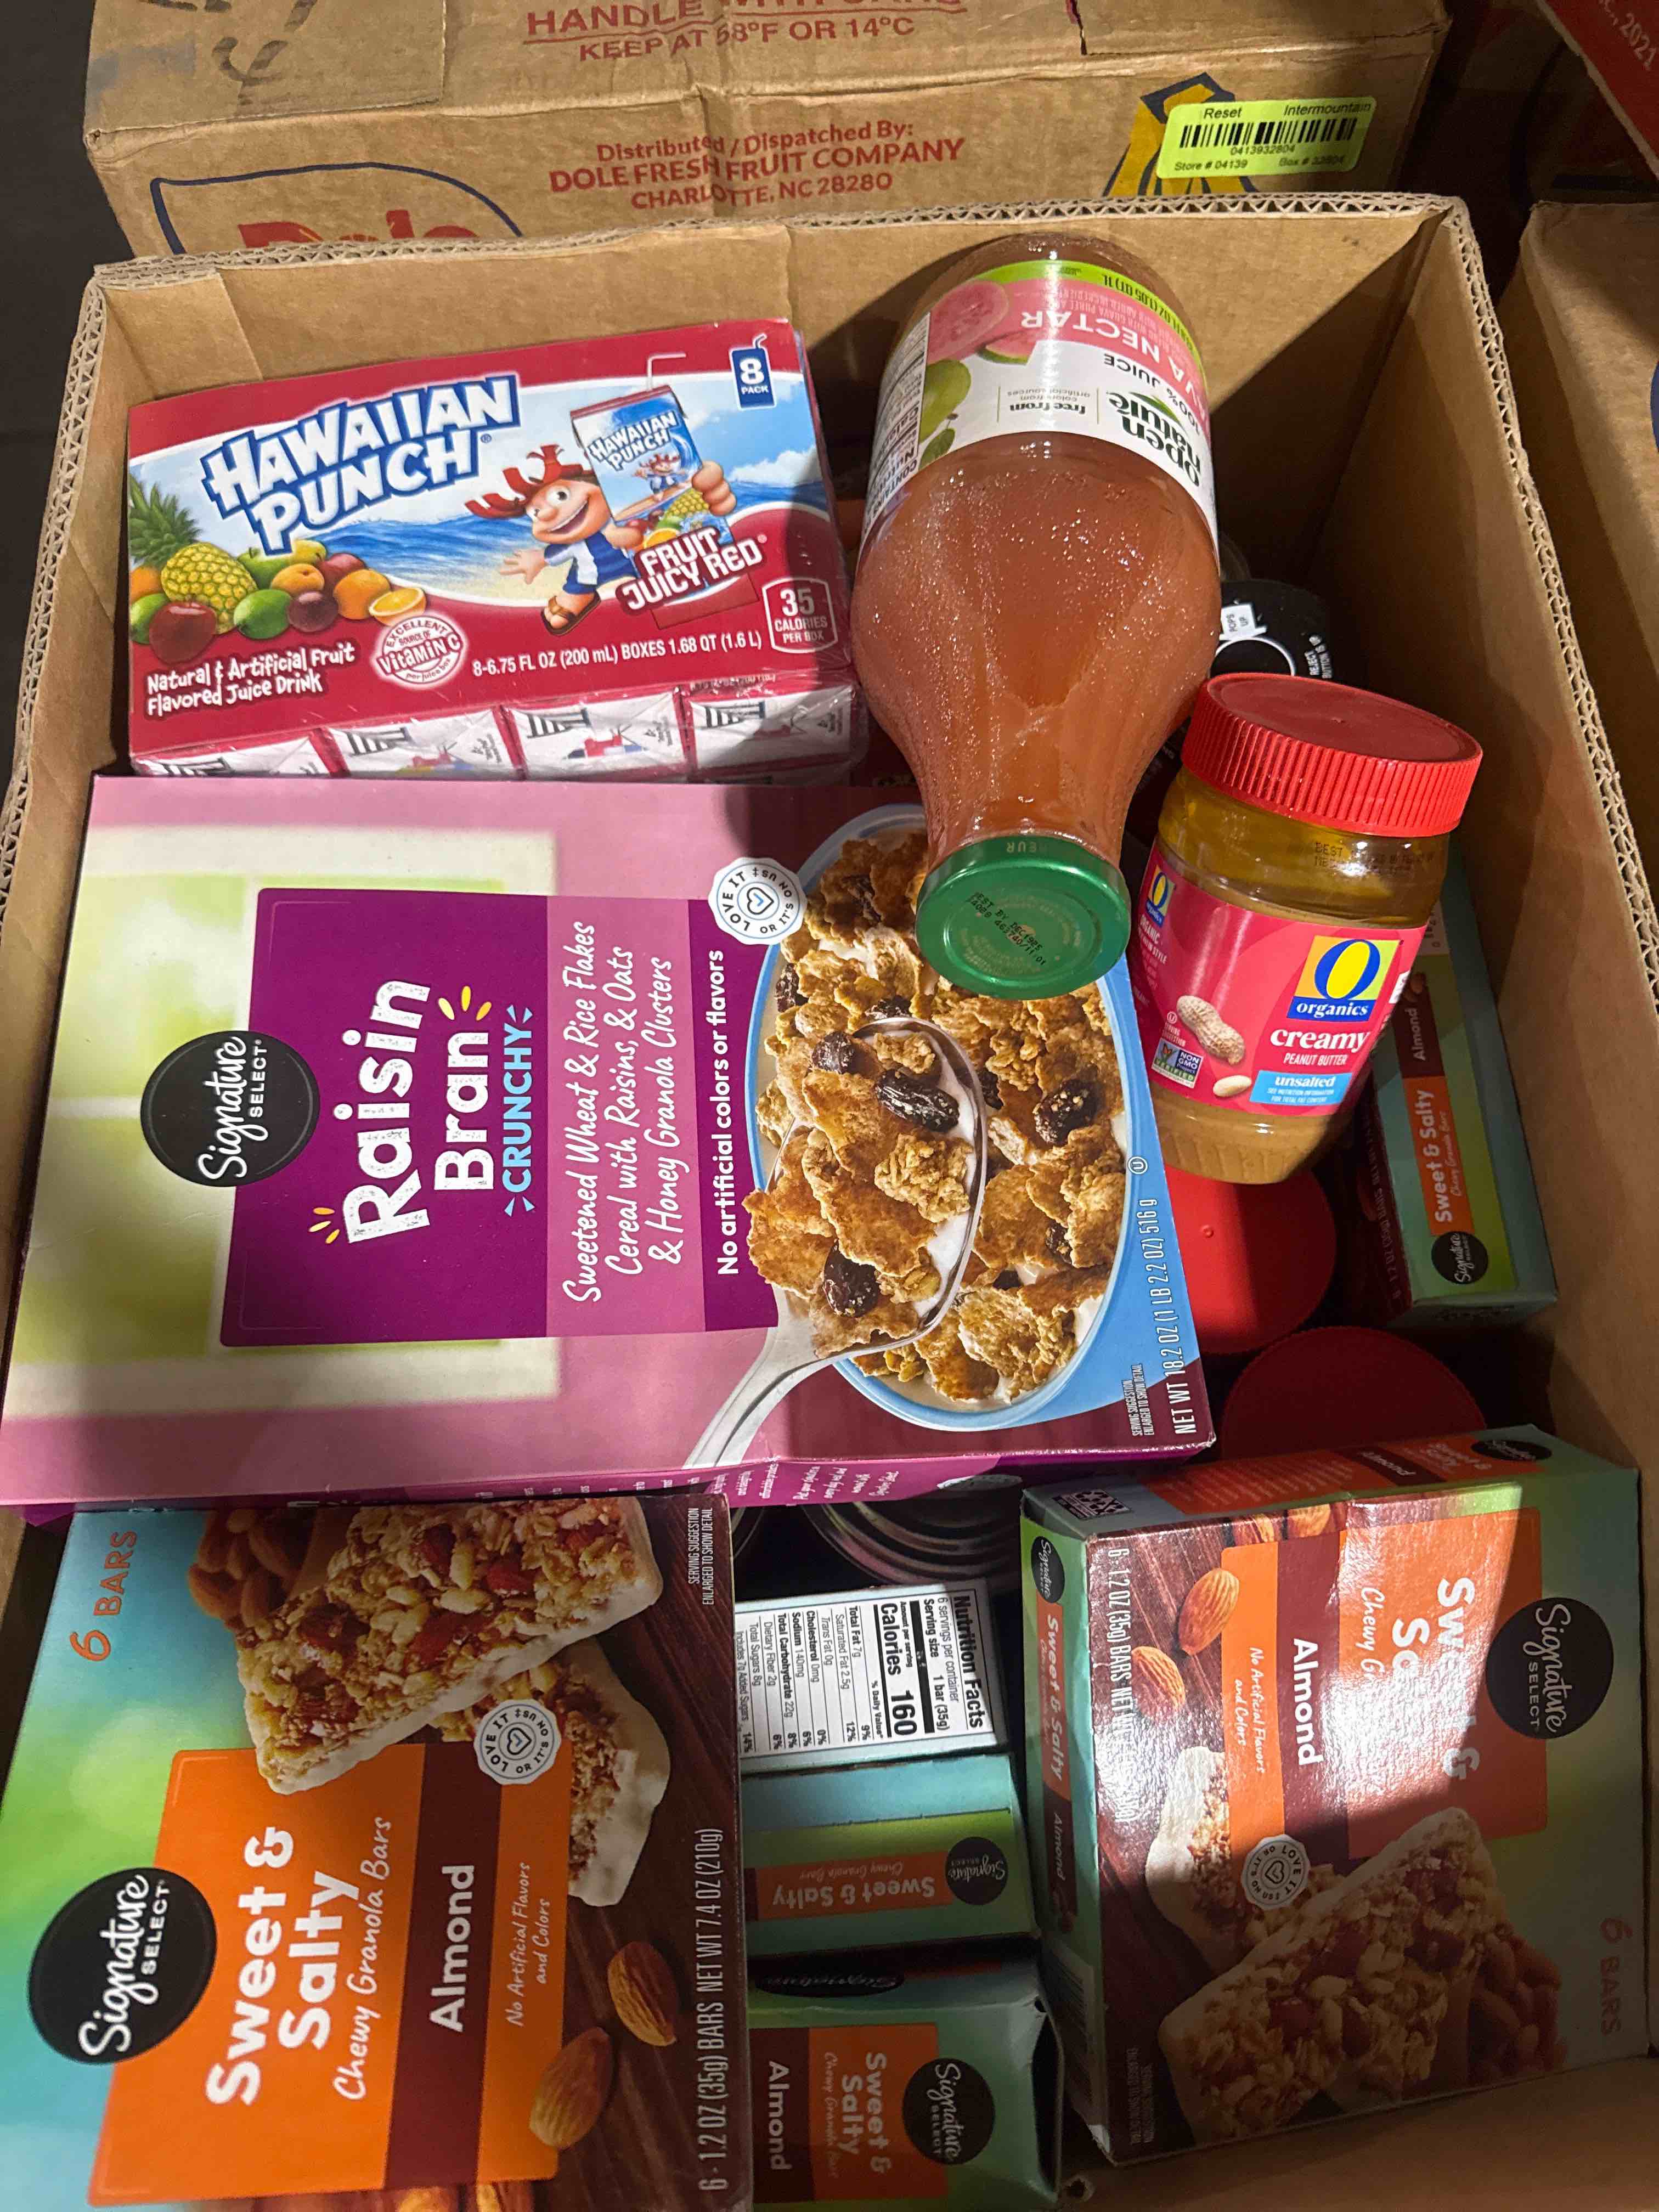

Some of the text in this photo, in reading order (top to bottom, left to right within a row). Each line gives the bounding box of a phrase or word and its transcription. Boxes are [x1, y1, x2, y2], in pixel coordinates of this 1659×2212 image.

[527, 3, 704, 36] HANDLE
[579, 37, 662, 62] KEEP
[670, 30, 708, 55] AT
[789, 20, 836, 42] OR
[1620, 13, 1656, 70] 2021
[597, 120, 913, 162] Distributed Dispatched By:
[1203, 103, 1372, 119] Reset Intermountain
[550, 138, 966, 192] DOLE FRESH FRUIT COMPANY
[631, 172, 893, 211] CHARLOTTE, NC 28280
[1174, 159, 1248, 171] Store 04139
[739, 357, 765, 385] 8
[1020, 311, 1160, 364] NECTAR
[741, 385, 769, 395] PACK
[1009, 402, 1086, 415] free from
[1103, 353, 1200, 436] 100% JUICE
[201, 375, 520, 518] HAWAIIAN
[589, 412, 678, 462] HAWAIIAN
[608, 430, 670, 471] PUNCH
[1120, 414, 1200, 487] open
[250, 430, 483, 556] PUNCH
[621, 540, 762, 610] JUICY RED
[640, 528, 718, 576] FRUIT
[774, 614, 827, 633] CALORIES
[780, 587, 815, 617] 35
[782, 631, 824, 644] PER BOX
[148, 663, 211, 693] Natural
[228, 648, 308, 682] Artificial
[311, 642, 355, 665] Fruit
[472, 630, 762, 678] 8-6.75 FL OZ (200 mL) BOXES 1.68 QT (1.6 L)
[148, 687, 222, 716] Flavored
[225, 682, 272, 705] Juice
[1270, 1029, 1371, 1053] creamy
[1295, 1000, 1369, 1019] organics
[1178, 1058, 1198, 1070] GMO
[1180, 1052, 1200, 1064] NON
[1274, 1076, 1336, 1088] unsalted
[1283, 1053, 1348, 1066] PEANUT BUTTER
[198, 1036, 268, 1180] Signature
[333, 979, 431, 1244] Raisin
[435, 1032, 494, 1191] Bran
[502, 1023, 534, 1193] CRUNCHY
[562, 921, 602, 1303] Sweetened Wheat & Rice Flakes
[603, 945, 643, 1277] Cereal with Raisins, & Oats
[640, 957, 690, 1265] & Honey Granola Clusters
[704, 949, 739, 1276] No artificial colors or flavors
[1419, 1088, 1437, 1142] Salty
[1432, 1161, 1453, 1223] Sweet
[1137, 1198, 1197, 1435] NET WT 18.2 OZ (1 LB 2.2 OZ) 516 g
[69, 1530, 137, 1662] 6 BARS
[881, 1603, 917, 1736] Calories 160
[924, 1599, 950, 1731] Serving size bar (35g)
[939, 1605, 960, 1702] servings per container
[953, 1595, 985, 1729] Nutrition Facts
[1522, 1603, 1573, 1734] Signature
[1249, 1667, 1266, 1775] Artificial Flavors
[1294, 1638, 1324, 1766] Almond
[1528, 1661, 1539, 1730] SELECT
[78, 1874, 159, 2056] Signature
[142, 1884, 172, 1975] SELECT
[205, 1826, 294, 2106] Sweet &
[278, 1871, 360, 2050] Salty
[334, 1816, 393, 2100] Chewy Granola Bars
[430, 1865, 475, 2033] Almond
[504, 1861, 532, 2028] No Artificial Flavors
[533, 1898, 550, 1985] and Colors
[695, 1830, 729, 2190] 6 1.2 OZ (35g) BARS NET WT 7.4 OZ (210g)
[768, 2060, 793, 2171] Almond
[842, 2074, 861, 2155] Salty
[865, 2052, 889, 2142] Sweet
